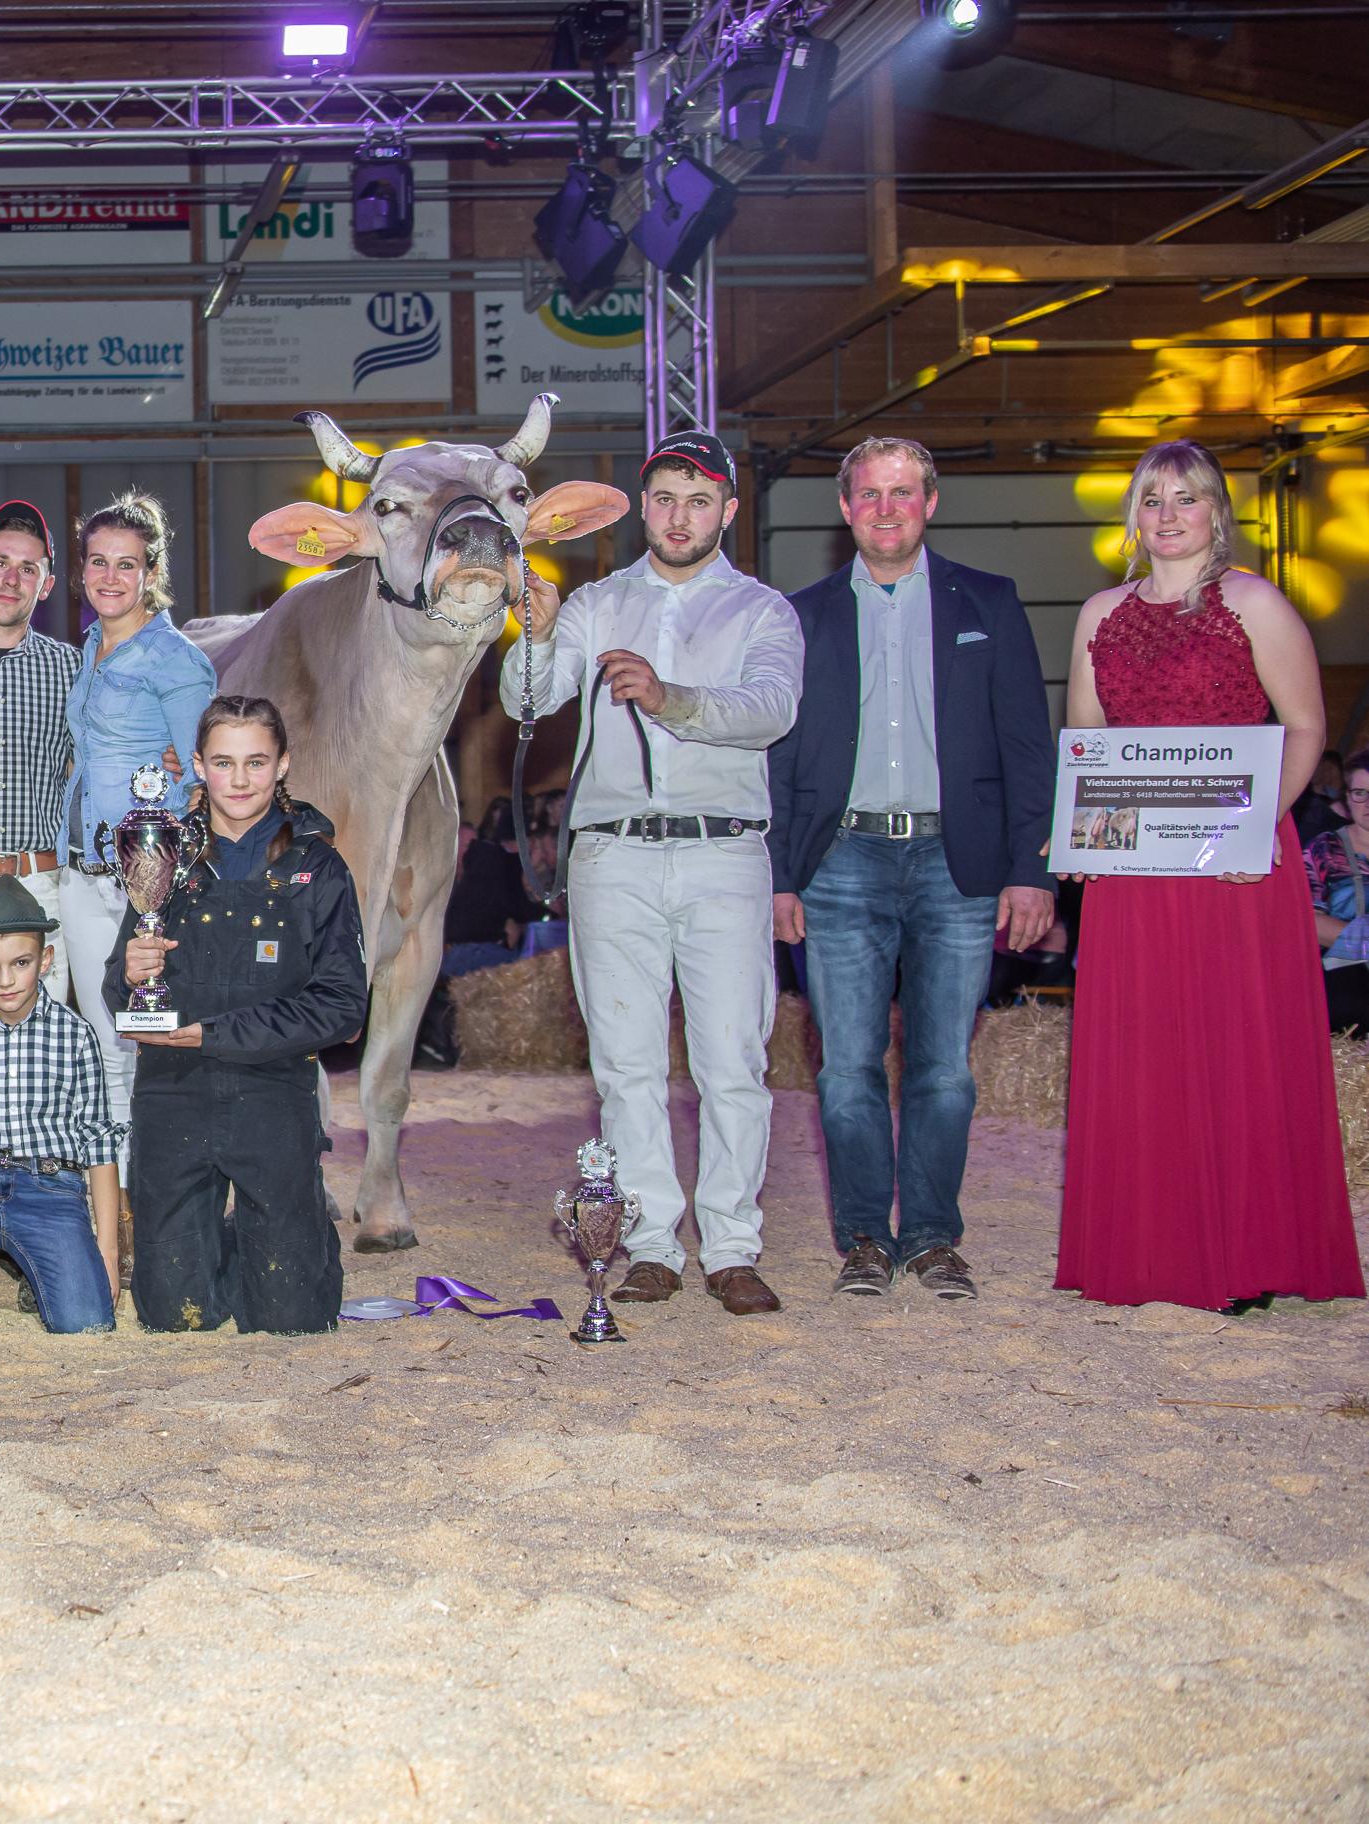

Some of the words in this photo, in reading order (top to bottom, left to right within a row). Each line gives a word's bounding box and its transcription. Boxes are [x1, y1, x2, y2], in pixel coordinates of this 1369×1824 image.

[229, 293, 352, 310] FA-Beratungsdienste
[373, 292, 427, 334] UFA
[98, 335, 184, 367] Bauer
[521, 366, 545, 384] Der
[550, 363, 646, 385] Mineralstoffsp
[45, 385, 75, 397] Zeitung
[77, 385, 89, 396] für
[92, 386, 104, 396] die
[1120, 743, 1233, 765] Champion
[1085, 778, 1170, 788] Viehzuchtverband
[1172, 778, 1189, 787] des
[1191, 778, 1205, 787] Kt.
[1206, 778, 1244, 788] Schwyz
[1083, 791, 1121, 799] Landstrasse
[1121, 791, 1131, 799] 35
[1136, 791, 1152, 799] 6418
[1153, 791, 1196, 799] Rothenthurm
[1144, 823, 1201, 833] Qualitätsvieh
[1220, 823, 1240, 832] dem
[1190, 831, 1224, 841] Schwyz
[130, 1015, 165, 1023] Champion
